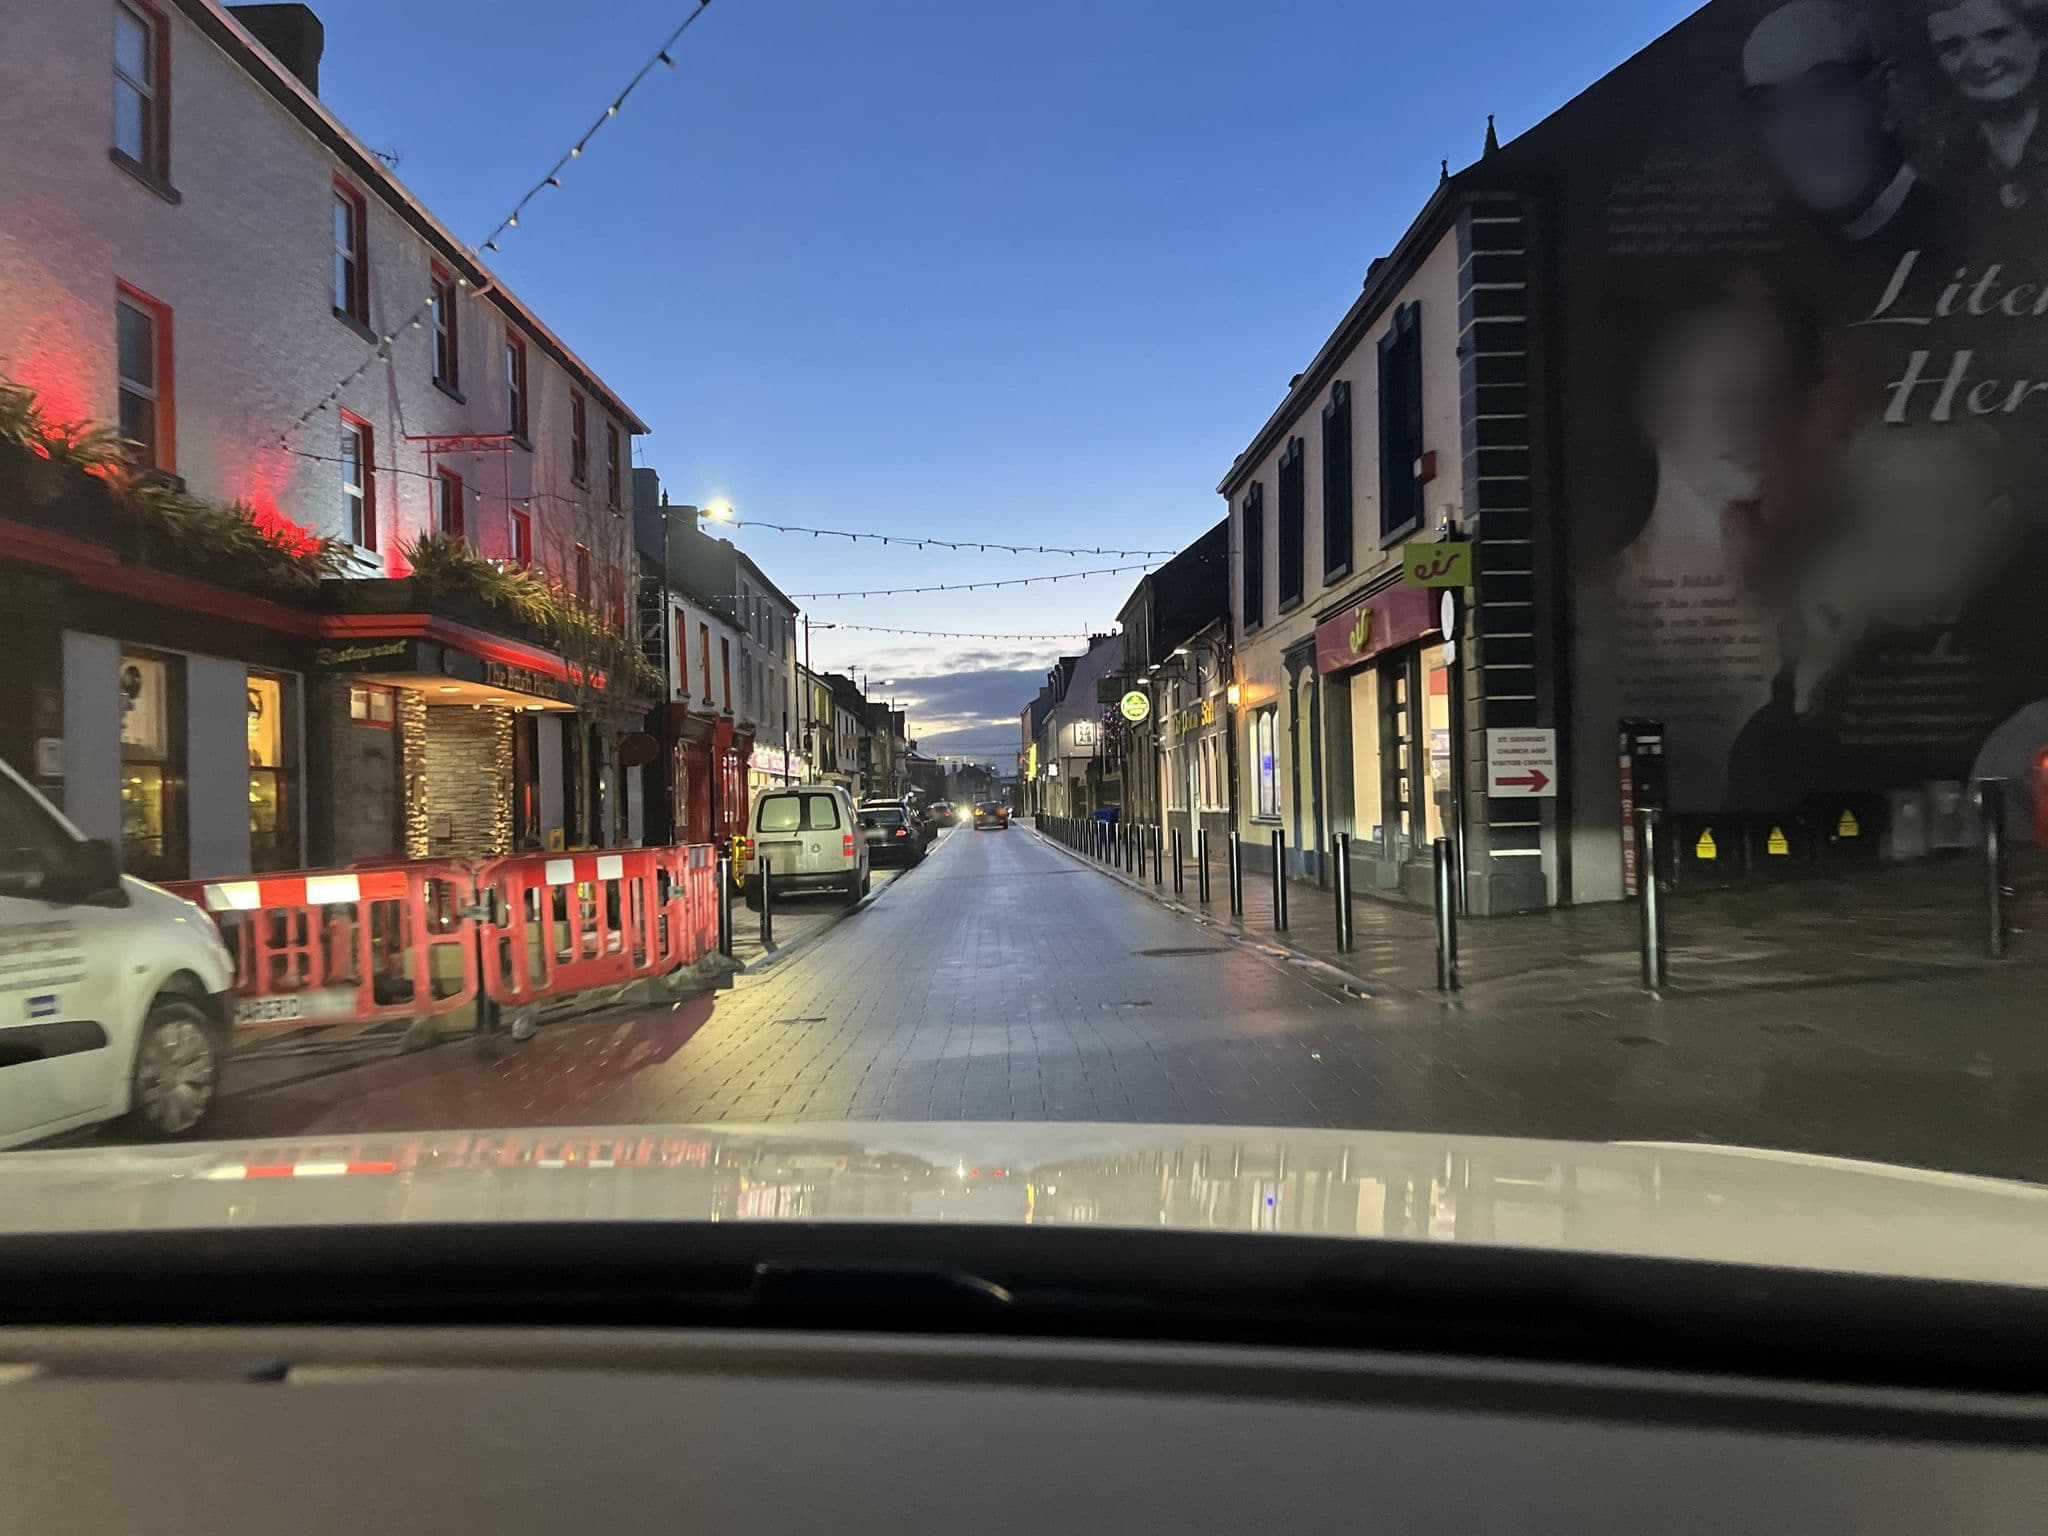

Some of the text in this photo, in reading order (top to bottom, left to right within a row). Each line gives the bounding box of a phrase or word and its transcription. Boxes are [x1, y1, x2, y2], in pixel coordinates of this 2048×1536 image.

[1884, 349, 2048, 422] Her
[1414, 550, 1459, 580] eir
[486, 661, 559, 699] The Bush Hotel
